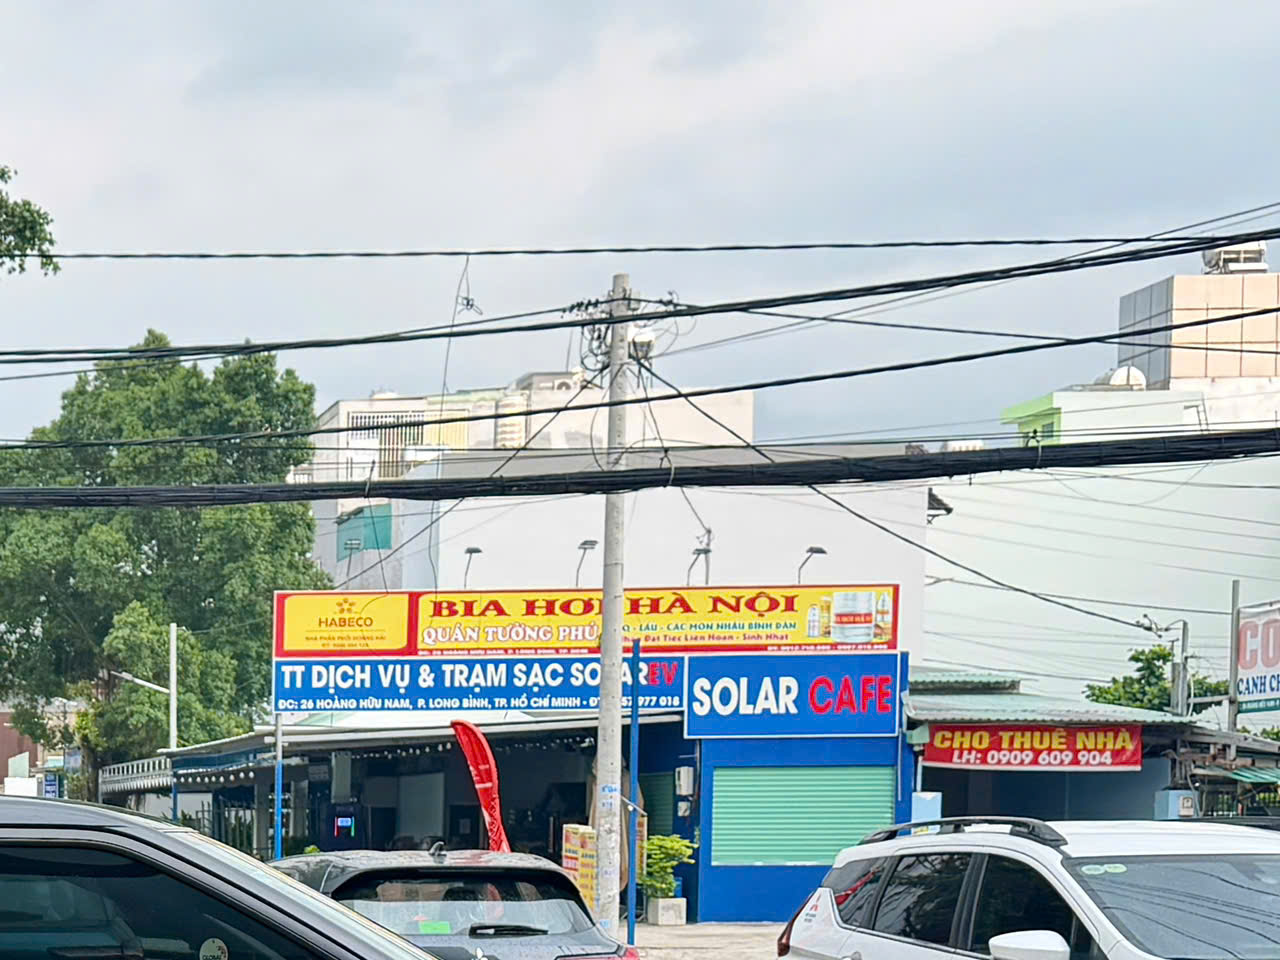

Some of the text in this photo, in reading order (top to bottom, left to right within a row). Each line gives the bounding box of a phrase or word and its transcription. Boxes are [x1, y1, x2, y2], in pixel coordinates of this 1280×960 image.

[428, 591, 799, 618] BIA HƠ HÀ NỘI
[318, 616, 374, 627] HABECO
[422, 623, 480, 646] QUÁN
[484, 621, 553, 642] TƯỜNG
[281, 665, 305, 688] TT
[311, 664, 371, 694] DỊCH
[377, 664, 411, 694] VỤ
[417, 664, 435, 688] &
[441, 663, 507, 693] TRẠM
[512, 662, 564, 693] SẠC
[1237, 674, 1267, 696] CANH
[300, 699, 314, 709] 26
[316, 695, 357, 709] HOÀNG
[359, 696, 382, 709] HỮU
[384, 698, 413, 711] NAM,
[429, 697, 460, 708] LONG
[462, 694, 492, 709] BÌNH,
[510, 693, 528, 708] HỒ
[530, 694, 551, 707] CHÍ
[551, 697, 581, 707] MINH
[659, 696, 680, 706] 018
[692, 674, 893, 716] SOLAR CAFE
[933, 728, 1134, 750] CHO THUÊ NHÀ
[952, 749, 1112, 766] LH: 0909 609 904
